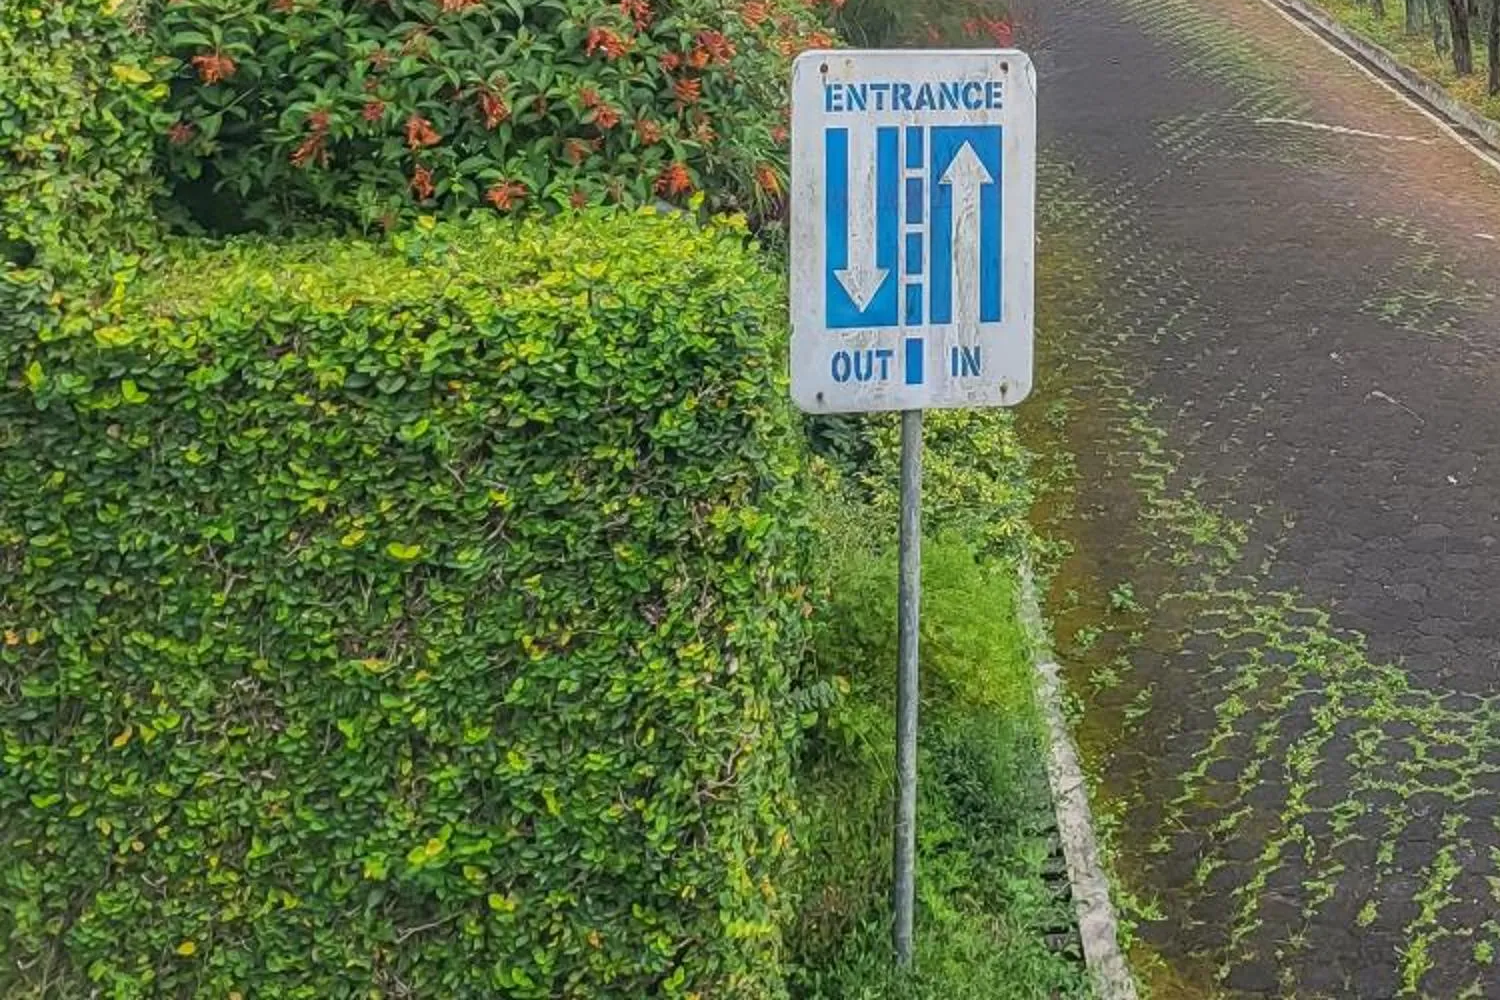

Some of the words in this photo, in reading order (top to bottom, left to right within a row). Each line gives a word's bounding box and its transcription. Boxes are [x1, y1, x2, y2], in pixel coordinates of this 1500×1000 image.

[825, 82, 1003, 113] ENTRANCE
[831, 350, 893, 382] OUT
[951, 346, 982, 377] IN
